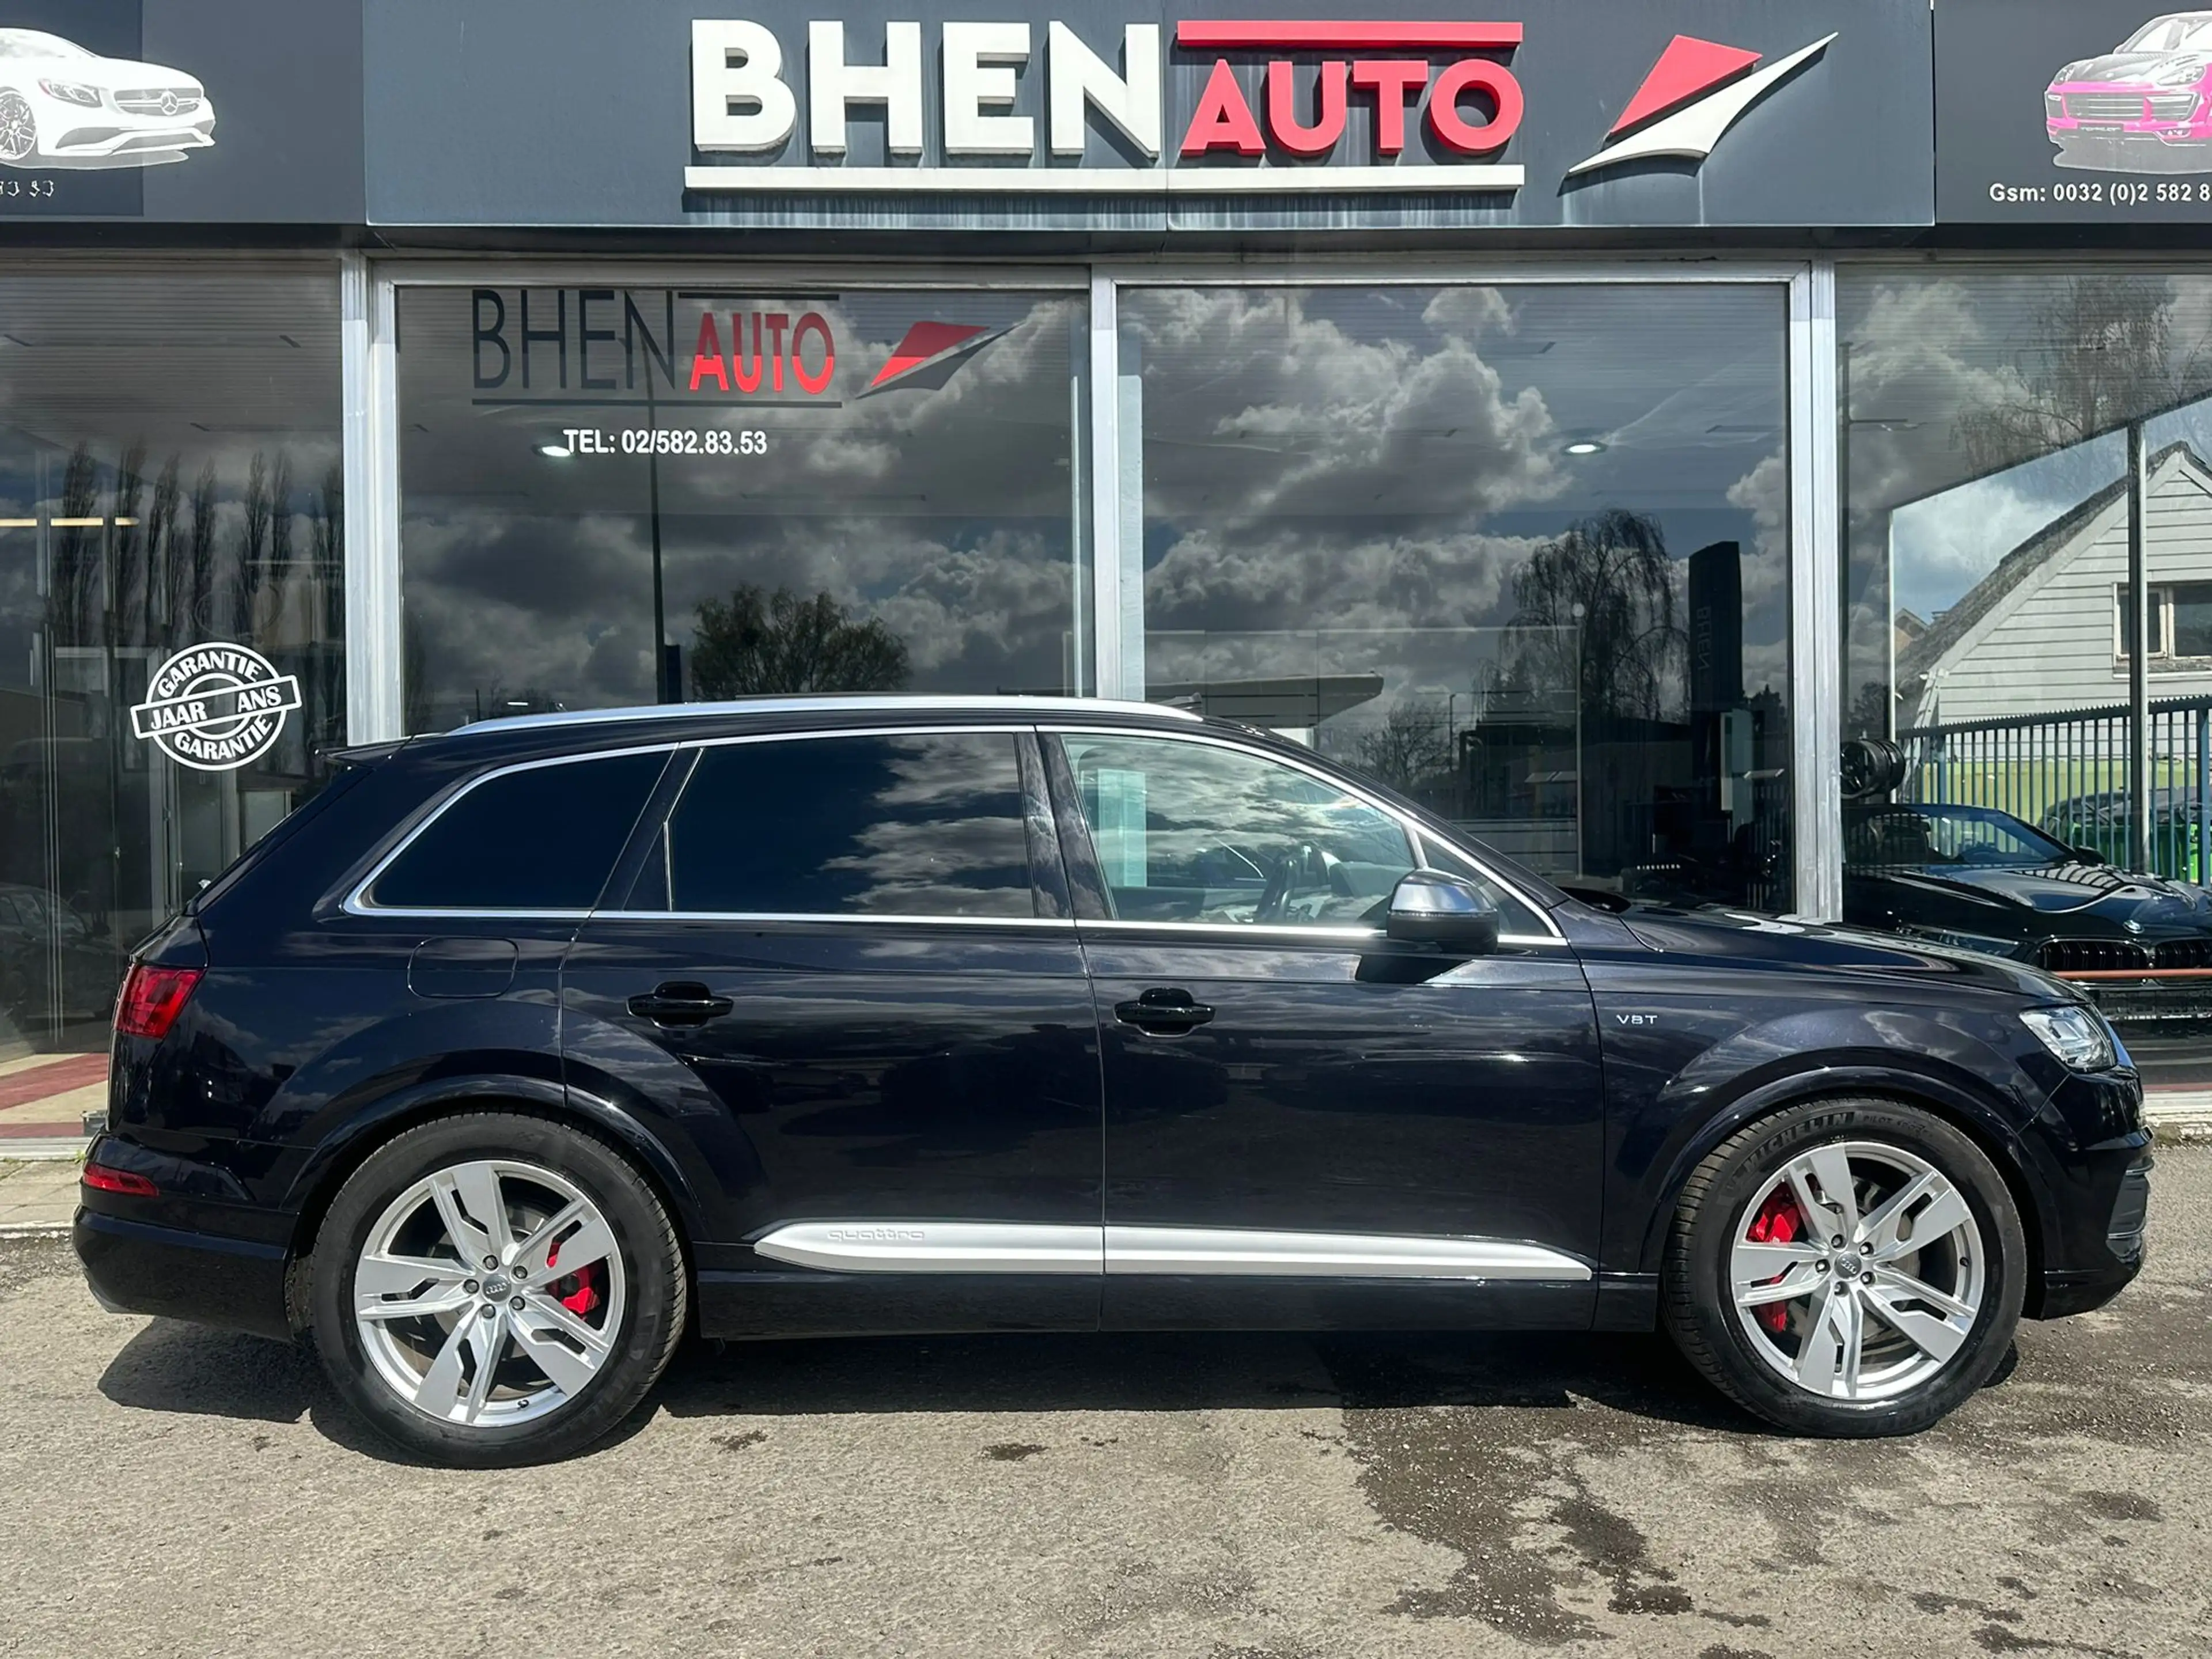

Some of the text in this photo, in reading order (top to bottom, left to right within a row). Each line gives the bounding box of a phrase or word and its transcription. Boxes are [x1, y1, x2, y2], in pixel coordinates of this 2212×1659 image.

[691, 20, 1524, 160] BHEN AUTO
[1989, 183, 2046, 202] Gsm:
[2053, 183, 2103, 202] 0032
[2109, 183, 2149, 206] (0)2
[2156, 183, 2192, 202] 582
[471, 289, 835, 394] BHEN AUTO
[563, 429, 768, 454] TEL: 02/582.83.53
[157, 651, 263, 698] GARANTIE
[150, 686, 282, 730] JAAR ANS
[174, 714, 274, 760] GARANTIE
[1616, 1014, 1658, 1025] V8T
[1741, 1112, 1849, 1174] MICHELIN
[827, 1228, 926, 1242] quattro
